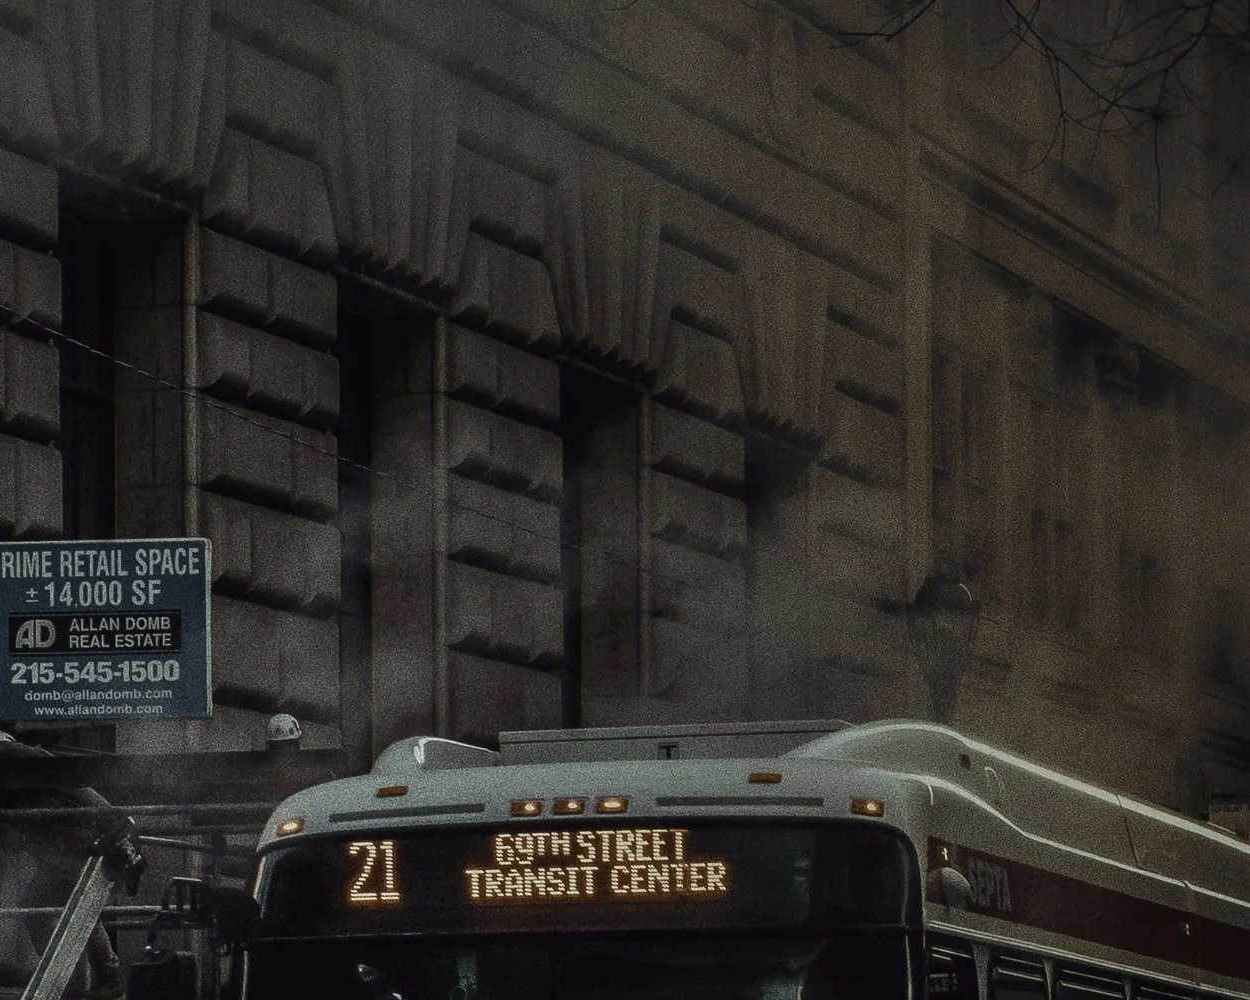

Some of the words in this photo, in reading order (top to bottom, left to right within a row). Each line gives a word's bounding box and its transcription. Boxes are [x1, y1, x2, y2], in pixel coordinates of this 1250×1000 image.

[59, 549, 129, 578] RETAIL
[135, 547, 200, 576] SPACE
[44, 580, 123, 608] 14,000
[131, 579, 162, 606] SF
[14, 619, 56, 649] AD
[69, 617, 121, 632] ALLAN
[125, 616, 172, 630] DOMB
[69, 634, 110, 649] REAL
[114, 633, 172, 648] ESTATE
[10, 659, 180, 685] 215-545-1500
[24, 688, 173, 702] domb@allandomb.com
[34, 704, 163, 717] www.allandomb.com
[495, 831, 571, 866] 69TH
[575, 828, 689, 863] STREET
[349, 840, 401, 901] 21
[465, 866, 599, 899] TRANSIT
[610, 862, 727, 894] CENTER
